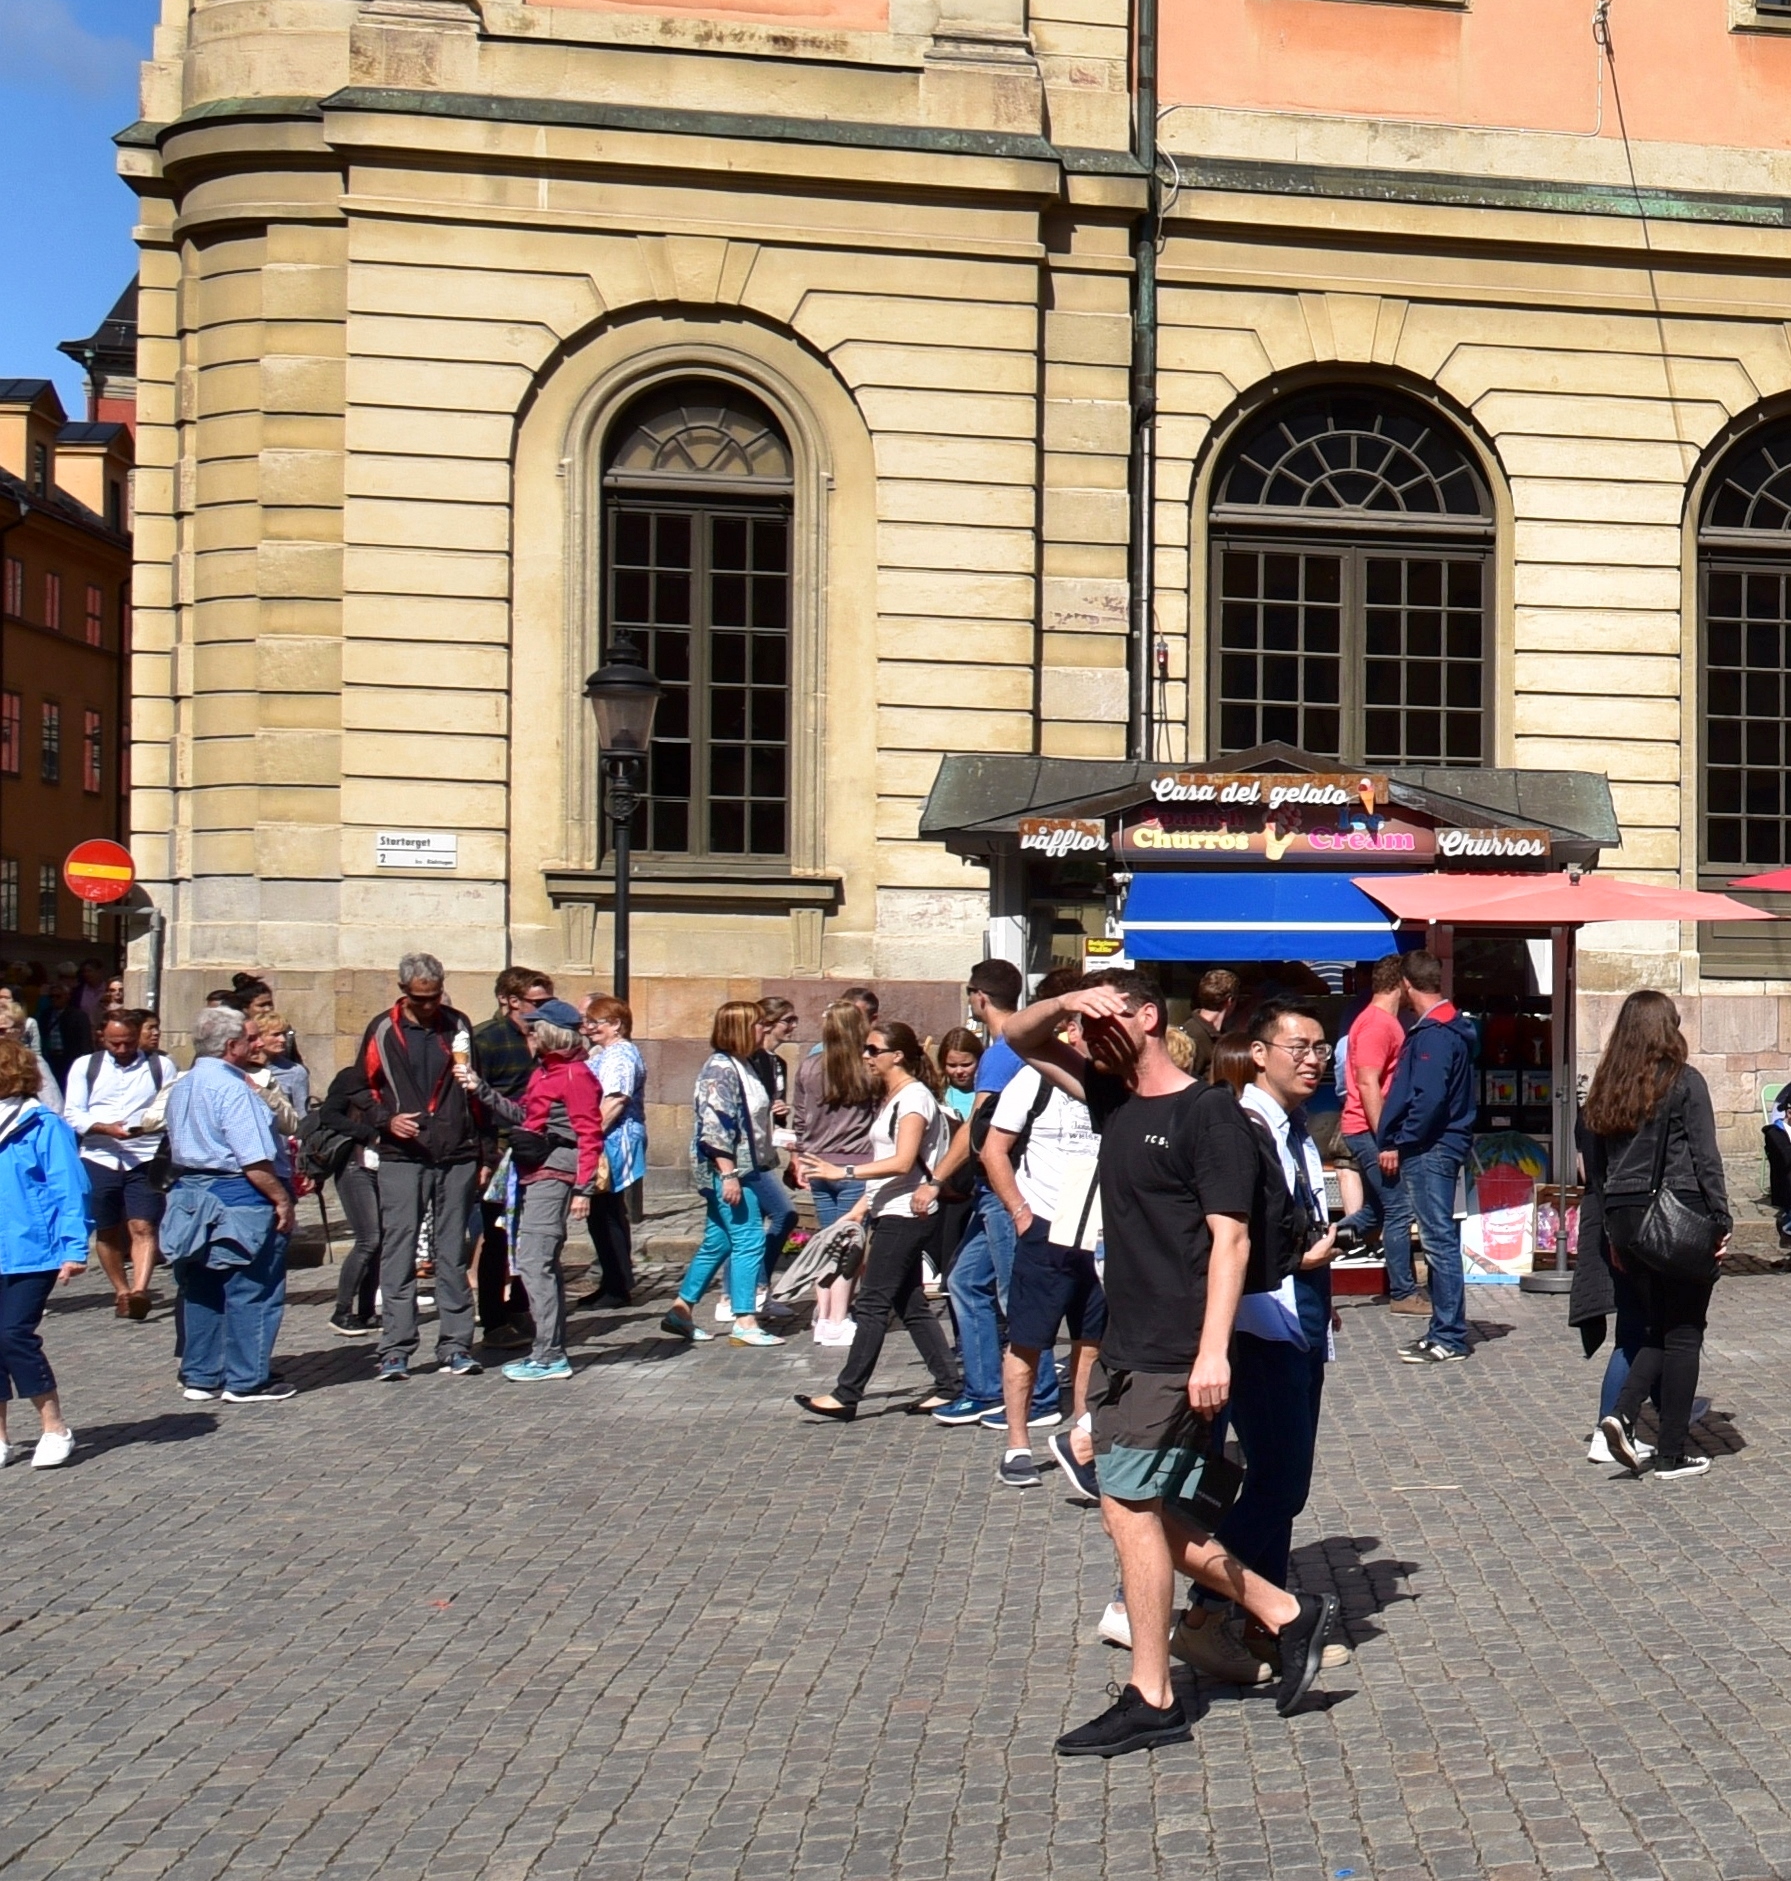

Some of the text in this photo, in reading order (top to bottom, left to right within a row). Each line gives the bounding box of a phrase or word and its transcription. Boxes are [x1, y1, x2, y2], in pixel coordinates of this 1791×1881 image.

[1150, 777, 1350, 810] Casa del gelato
[1141, 807, 1246, 829] Spanish
[1337, 808, 1385, 830] Ice
[380, 836, 431, 849] Stortorget
[1020, 827, 1110, 858] våfflor
[1132, 828, 1249, 850] Churros
[1308, 827, 1415, 851] Cream
[1438, 830, 1545, 857] Churros
[380, 853, 386, 863] 2
